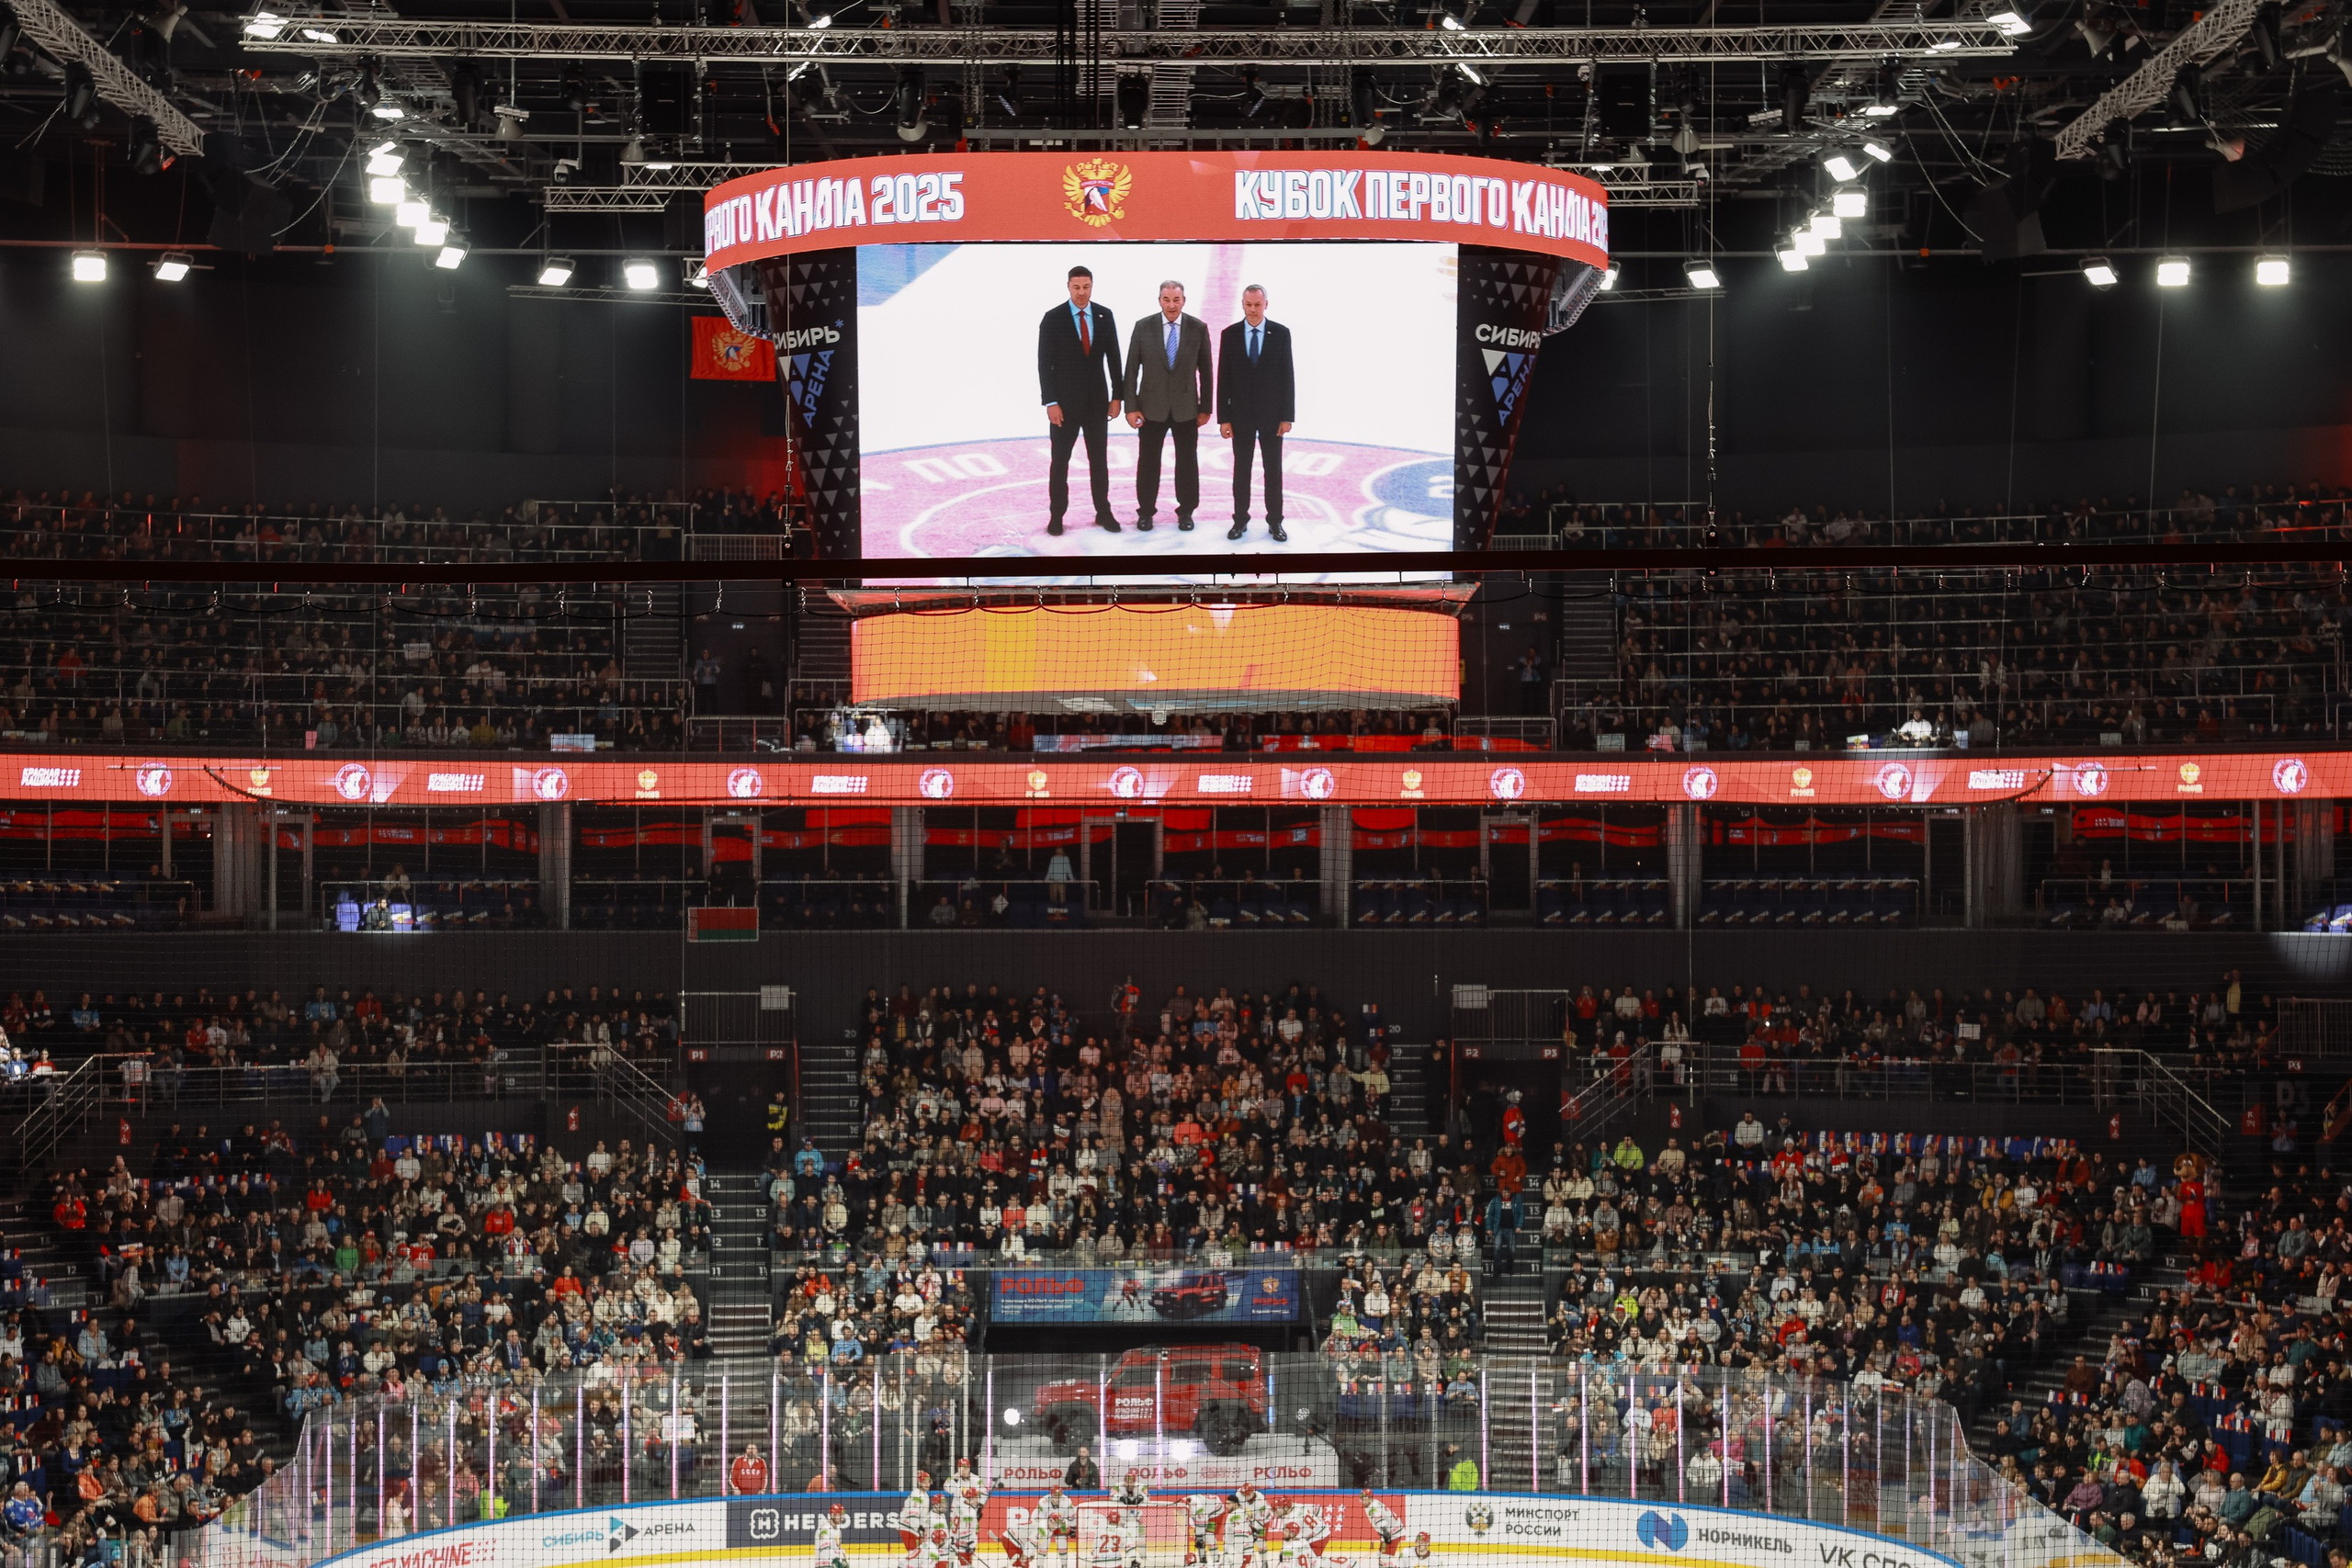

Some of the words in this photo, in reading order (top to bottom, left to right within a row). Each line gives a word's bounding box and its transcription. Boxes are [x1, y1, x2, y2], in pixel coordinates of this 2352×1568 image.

[870, 171, 965, 226] 2025
[1235, 169, 1363, 220] КУБОК
[1364, 170, 1509, 231] ПЕРВОГО
[773, 325, 841, 351] СИБИРЬ
[1475, 323, 1542, 349] СИБИРЬ
[802, 349, 835, 429] АРЕНА
[1498, 354, 1536, 427] АРЕНА
[1529, 1179, 1539, 1188] 14
[756, 1208, 767, 1217] 13
[1530, 1205, 1540, 1215] 13
[1529, 1234, 1540, 1244] 12
[67, 1265, 76, 1275] 12
[711, 1267, 720, 1276] 11
[1531, 1263, 1540, 1272] 11
[1001, 1277, 1084, 1293] РОЛЬФ
[2141, 1287, 2149, 1297] 11
[1114, 1397, 1154, 1406] РОЛЬФ
[1004, 1468, 1063, 1480] РОЛЬФ
[1505, 1507, 1579, 1521] МИНСПОРТ
[542, 1529, 605, 1549] СИБИРЬ
[643, 1522, 695, 1537] АРЕНА
[1505, 1523, 1562, 1537] РОССИИ
[1099, 1534, 1121, 1553] 23
[1699, 1529, 1793, 1554] НОРНИКЕЛЬ
[1819, 1542, 1856, 1568] VK
